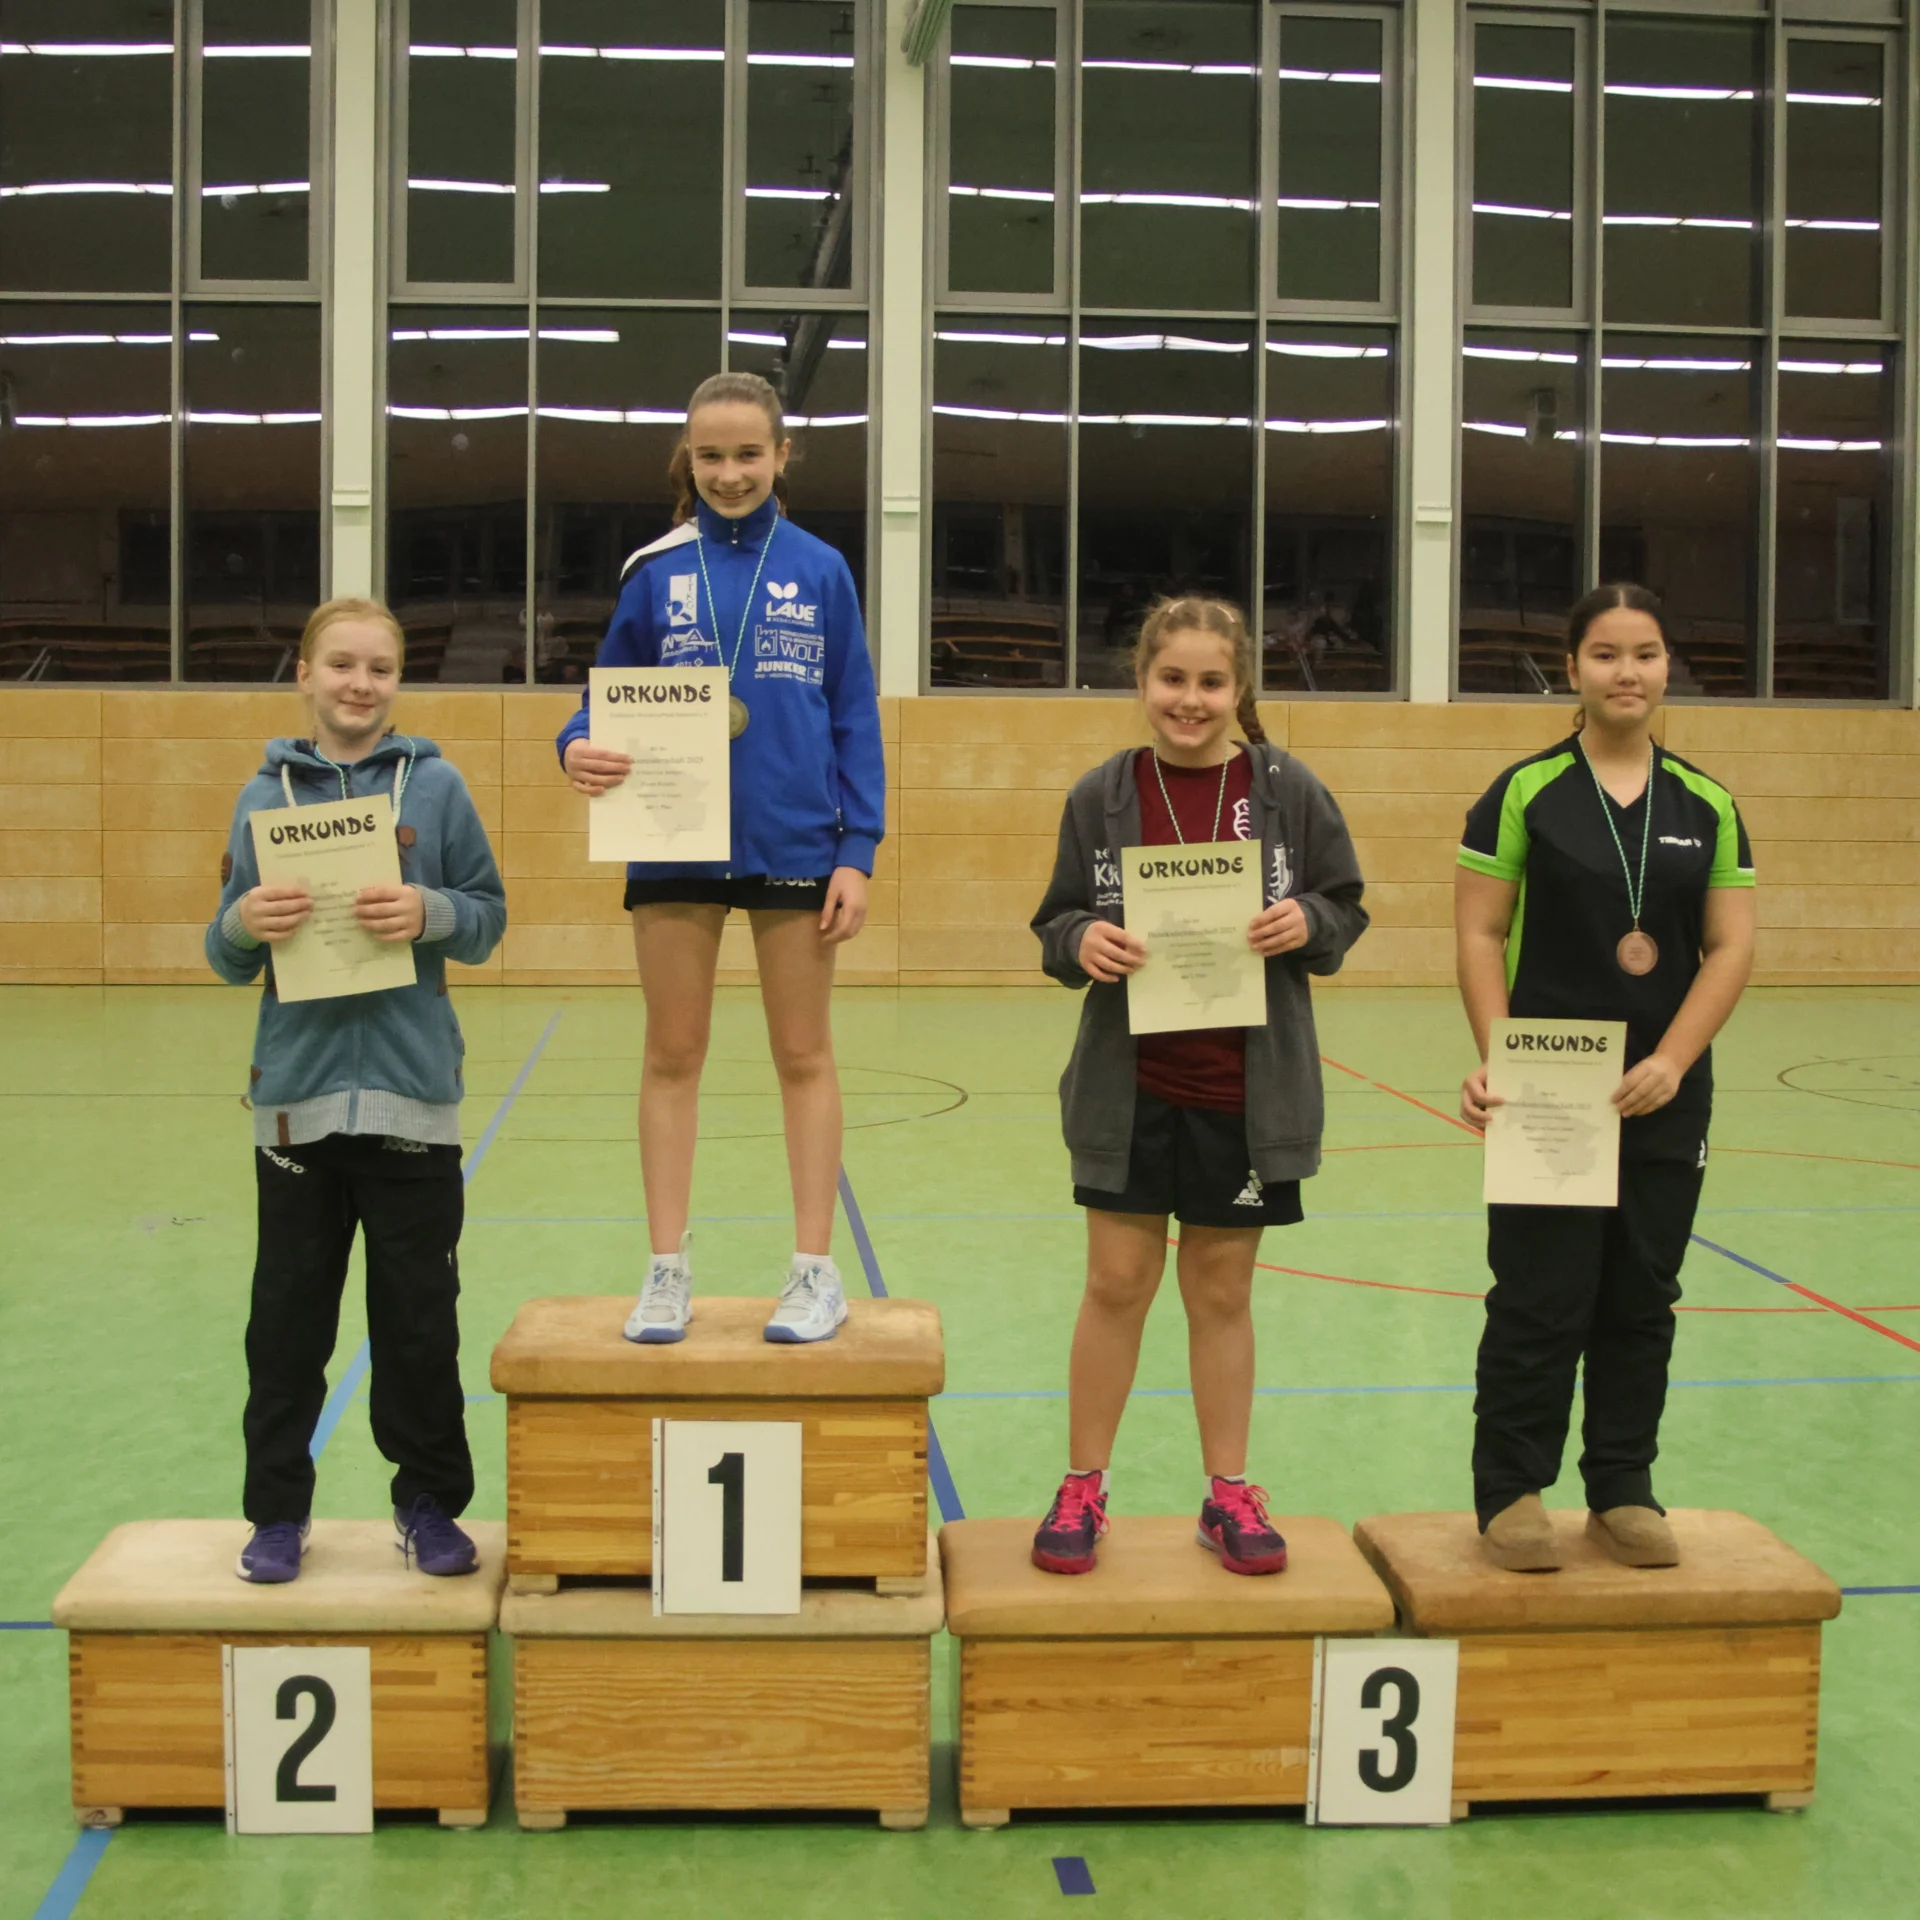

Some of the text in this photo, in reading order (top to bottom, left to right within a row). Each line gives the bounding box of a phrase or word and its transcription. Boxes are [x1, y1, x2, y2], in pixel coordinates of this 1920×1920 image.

[765, 601, 818, 622] LAUE
[779, 641, 824, 663] WOLF
[755, 661, 807, 677] JUNKER
[606, 684, 712, 704] URKUNDE
[269, 814, 376, 845] URKUNDE
[1139, 856, 1244, 880] URKUNDE
[1506, 1033, 1609, 1053] URKUNDE
[706, 1451, 745, 1583] 1
[274, 1674, 337, 1802] 2
[1357, 1666, 1421, 1793] 3
